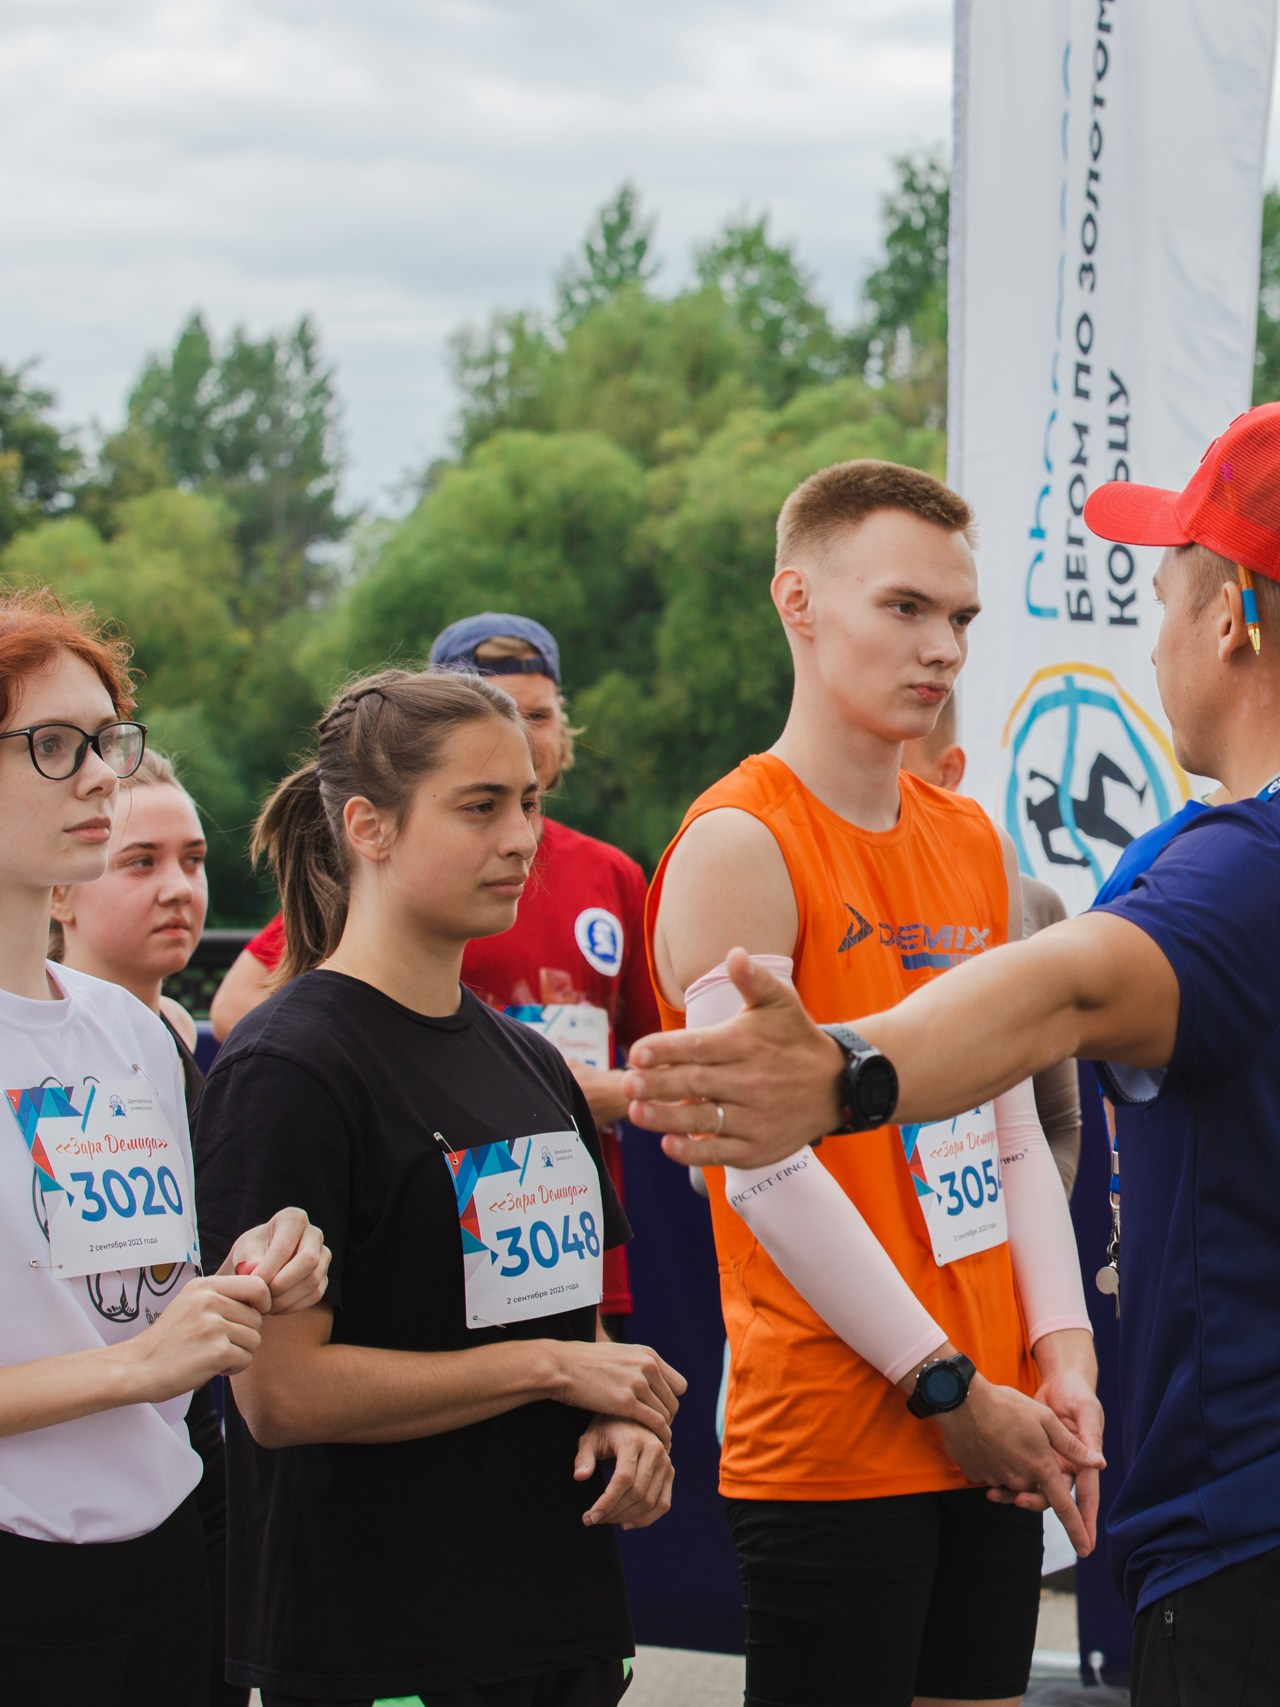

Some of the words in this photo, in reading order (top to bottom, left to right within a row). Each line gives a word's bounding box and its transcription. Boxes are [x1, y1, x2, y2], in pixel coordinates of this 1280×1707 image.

[1073, 313, 1094, 401] ПО
[1065, 420, 1095, 622] БЕГОМ
[1107, 368, 1138, 627] КОЬЦУ
[878, 921, 990, 951] DEMIX
[69, 1165, 183, 1223] 3020
[89, 1244, 94, 1252] 2
[95, 1240, 127, 1250] сентября
[128, 1237, 143, 1247] 2023
[143, 1237, 158, 1245] года
[495, 1210, 600, 1278] 3048
[506, 1297, 512, 1305] 2
[512, 1290, 548, 1303] сентября
[549, 1285, 565, 1295] 2023
[565, 1282, 579, 1291] года
